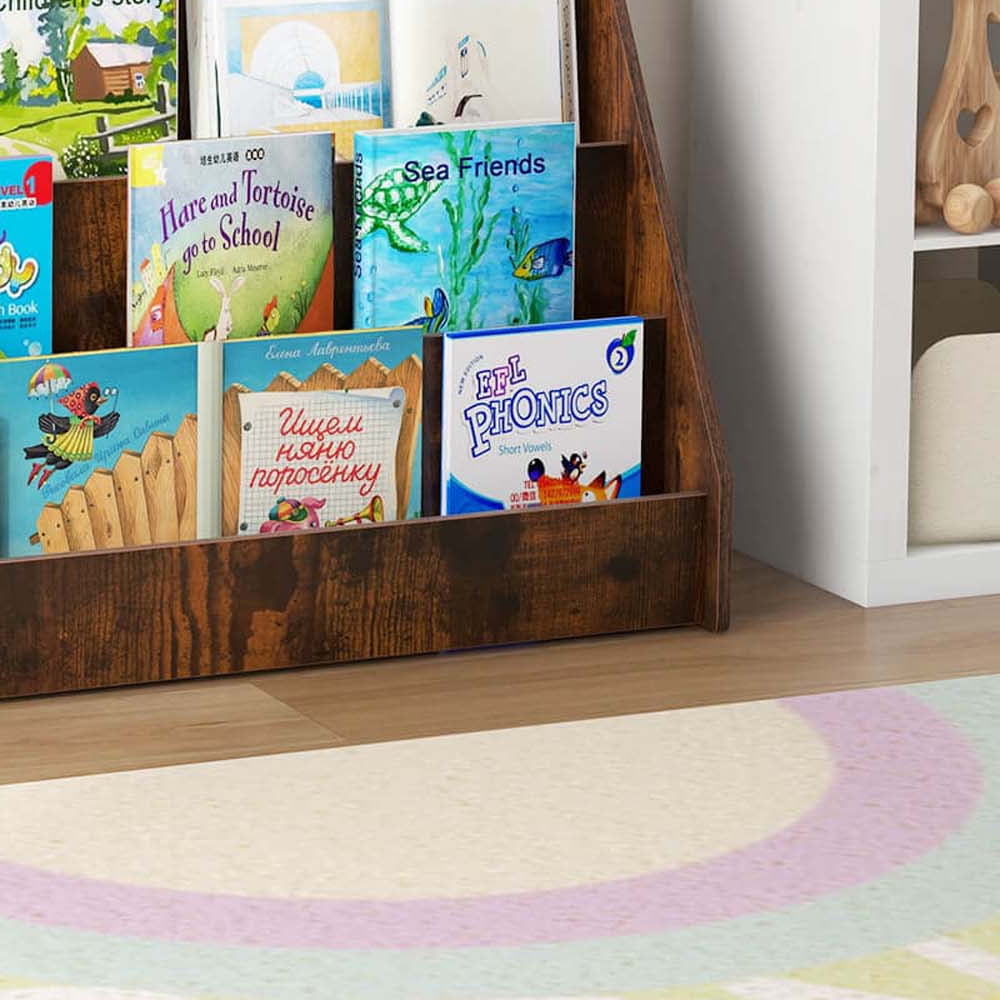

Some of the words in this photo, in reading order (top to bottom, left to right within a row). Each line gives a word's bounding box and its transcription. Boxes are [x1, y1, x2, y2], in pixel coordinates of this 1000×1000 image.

[404, 161, 449, 183] Sea
[459, 153, 546, 179] Friends
[27, 175, 36, 195] 1
[160, 195, 206, 244] Hare
[210, 182, 238, 210] and
[242, 169, 315, 222] Tortoise
[182, 243, 198, 275] go
[202, 232, 216, 254] to
[219, 212, 280, 251] School
[8, 299, 39, 316] Book
[264, 344, 301, 360] Елена
[615, 350, 624, 366] 2
[476, 354, 527, 400] EFL
[279, 407, 365, 441] Ищем
[464, 379, 609, 457] PHONICS
[276, 440, 356, 462] няню
[498, 444, 521, 456] Short
[523, 440, 552, 453] Vowels
[249, 460, 381, 497] поросёнку
